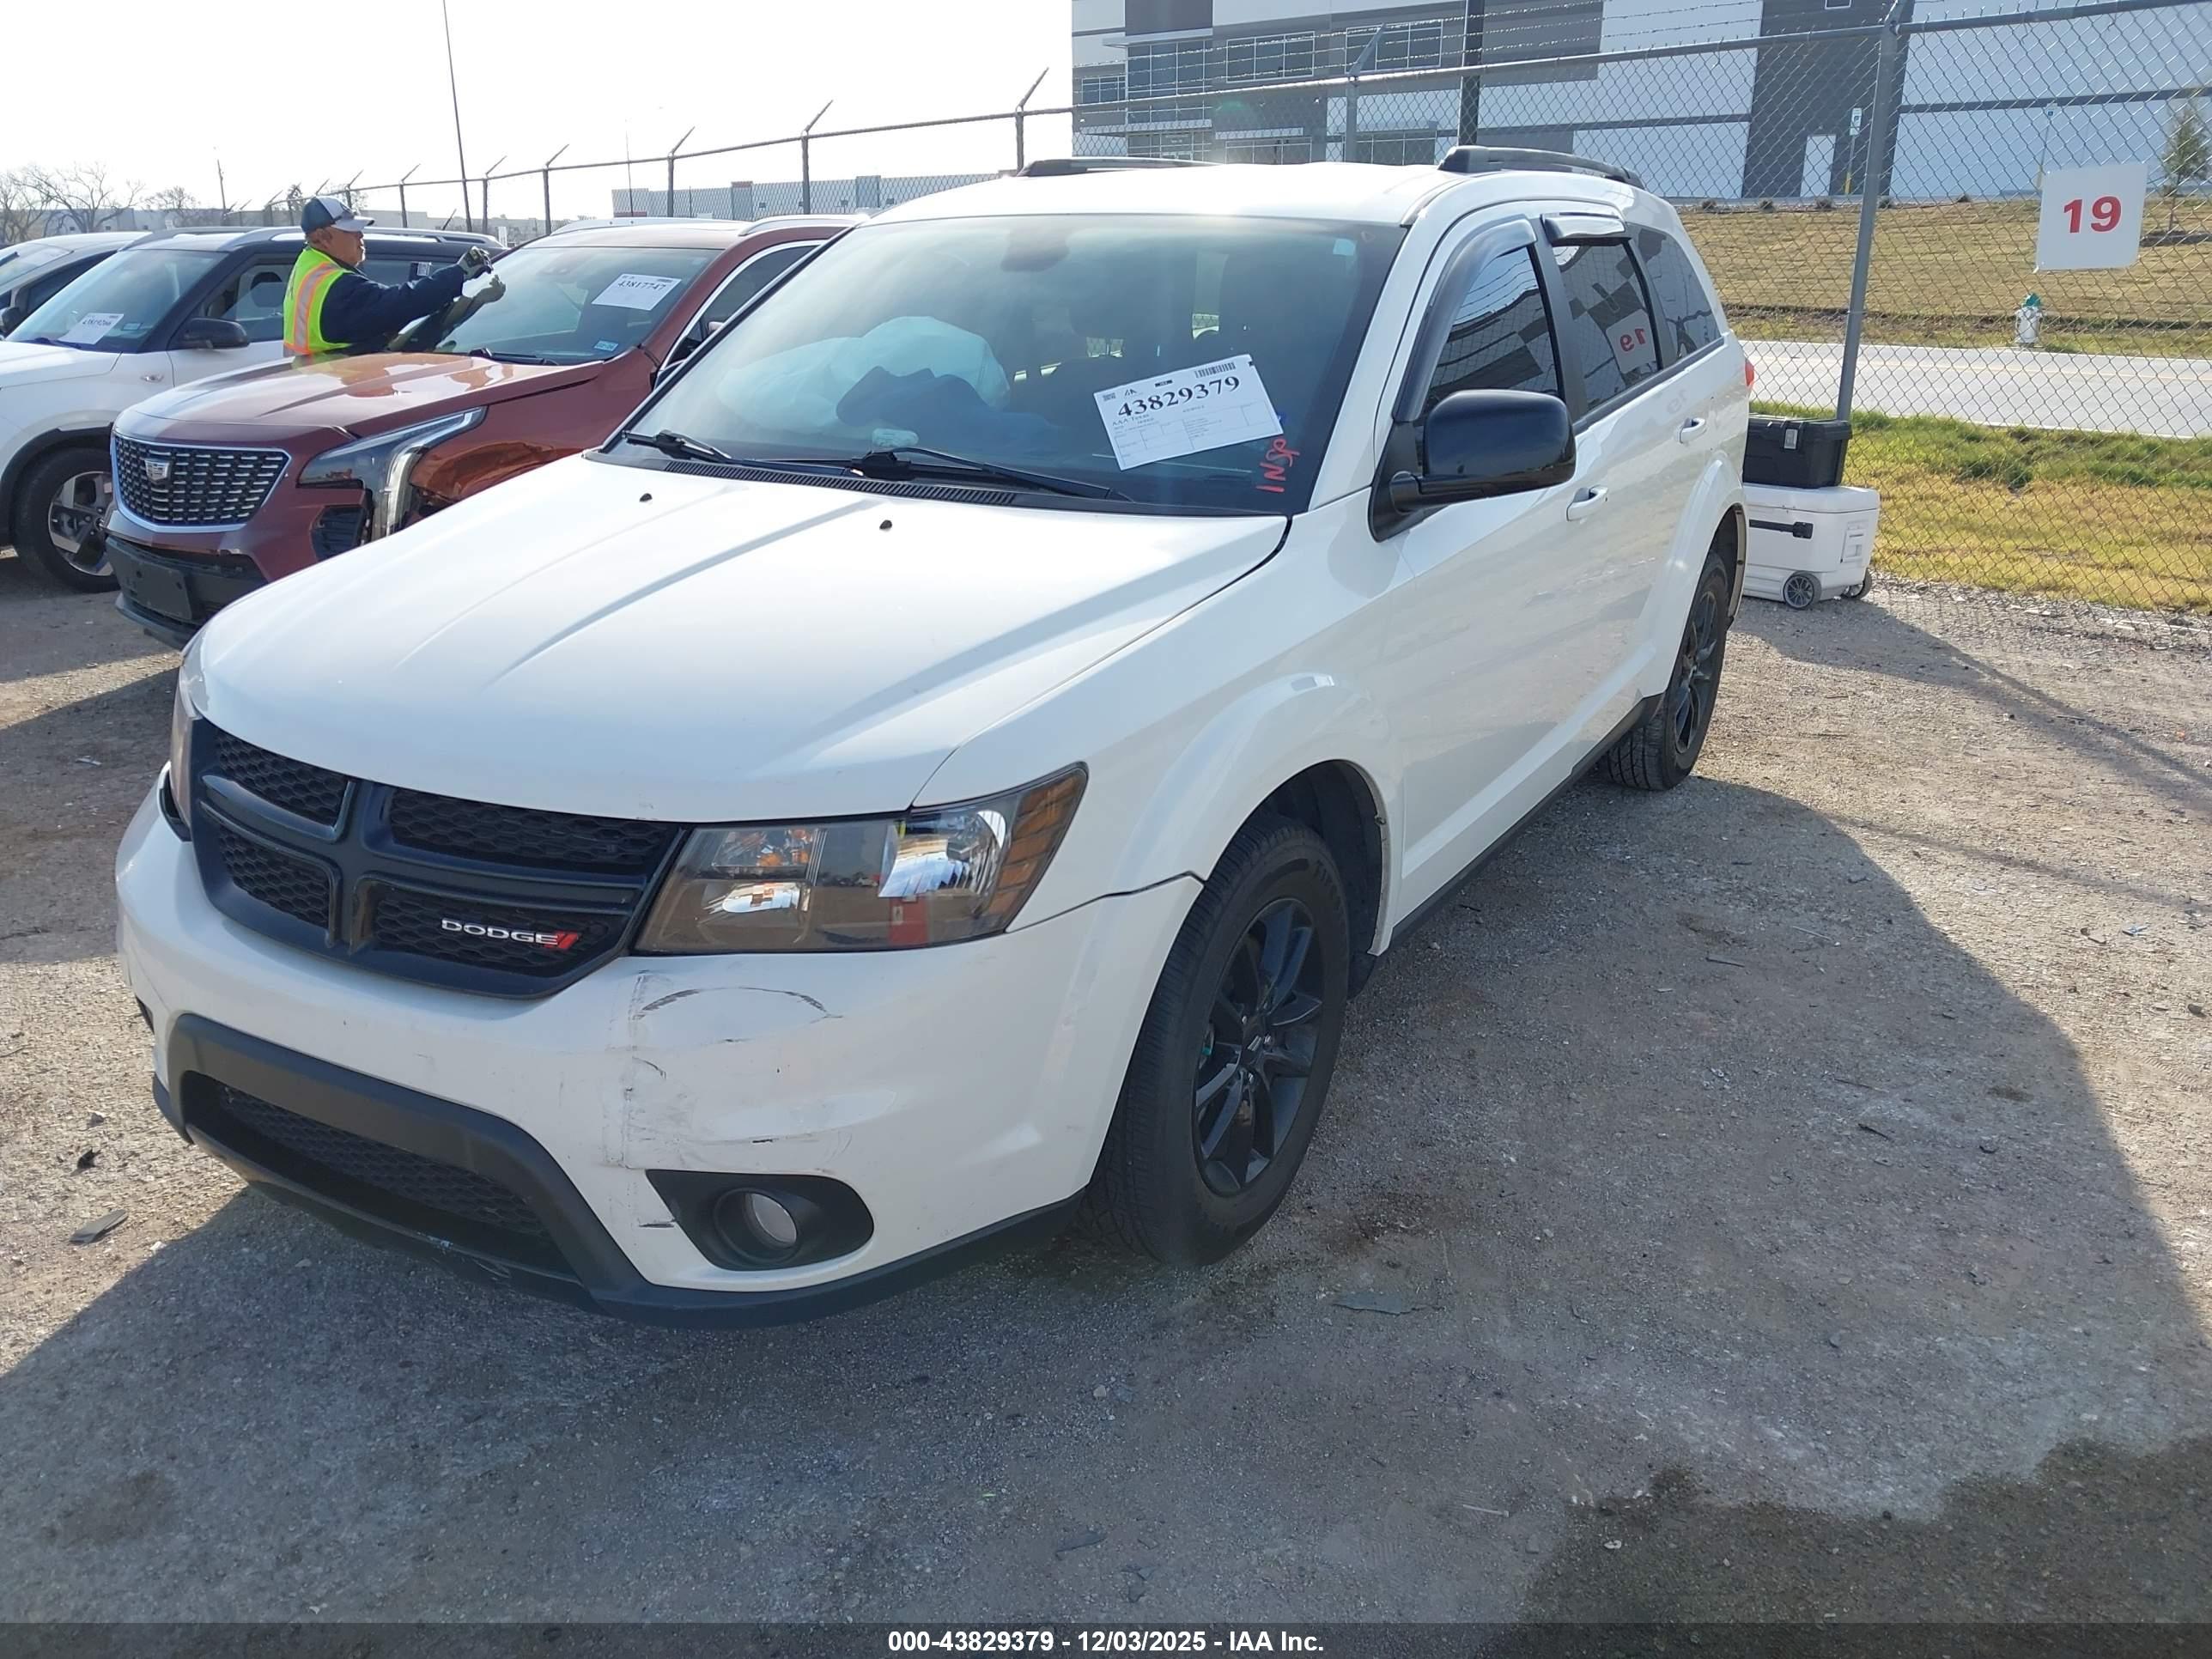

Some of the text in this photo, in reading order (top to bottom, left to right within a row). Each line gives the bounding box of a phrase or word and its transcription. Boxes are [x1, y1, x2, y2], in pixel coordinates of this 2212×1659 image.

[2063, 196, 2122, 234] 19
[1118, 375, 1241, 417] 43829379
[441, 918, 558, 945] DODGE
